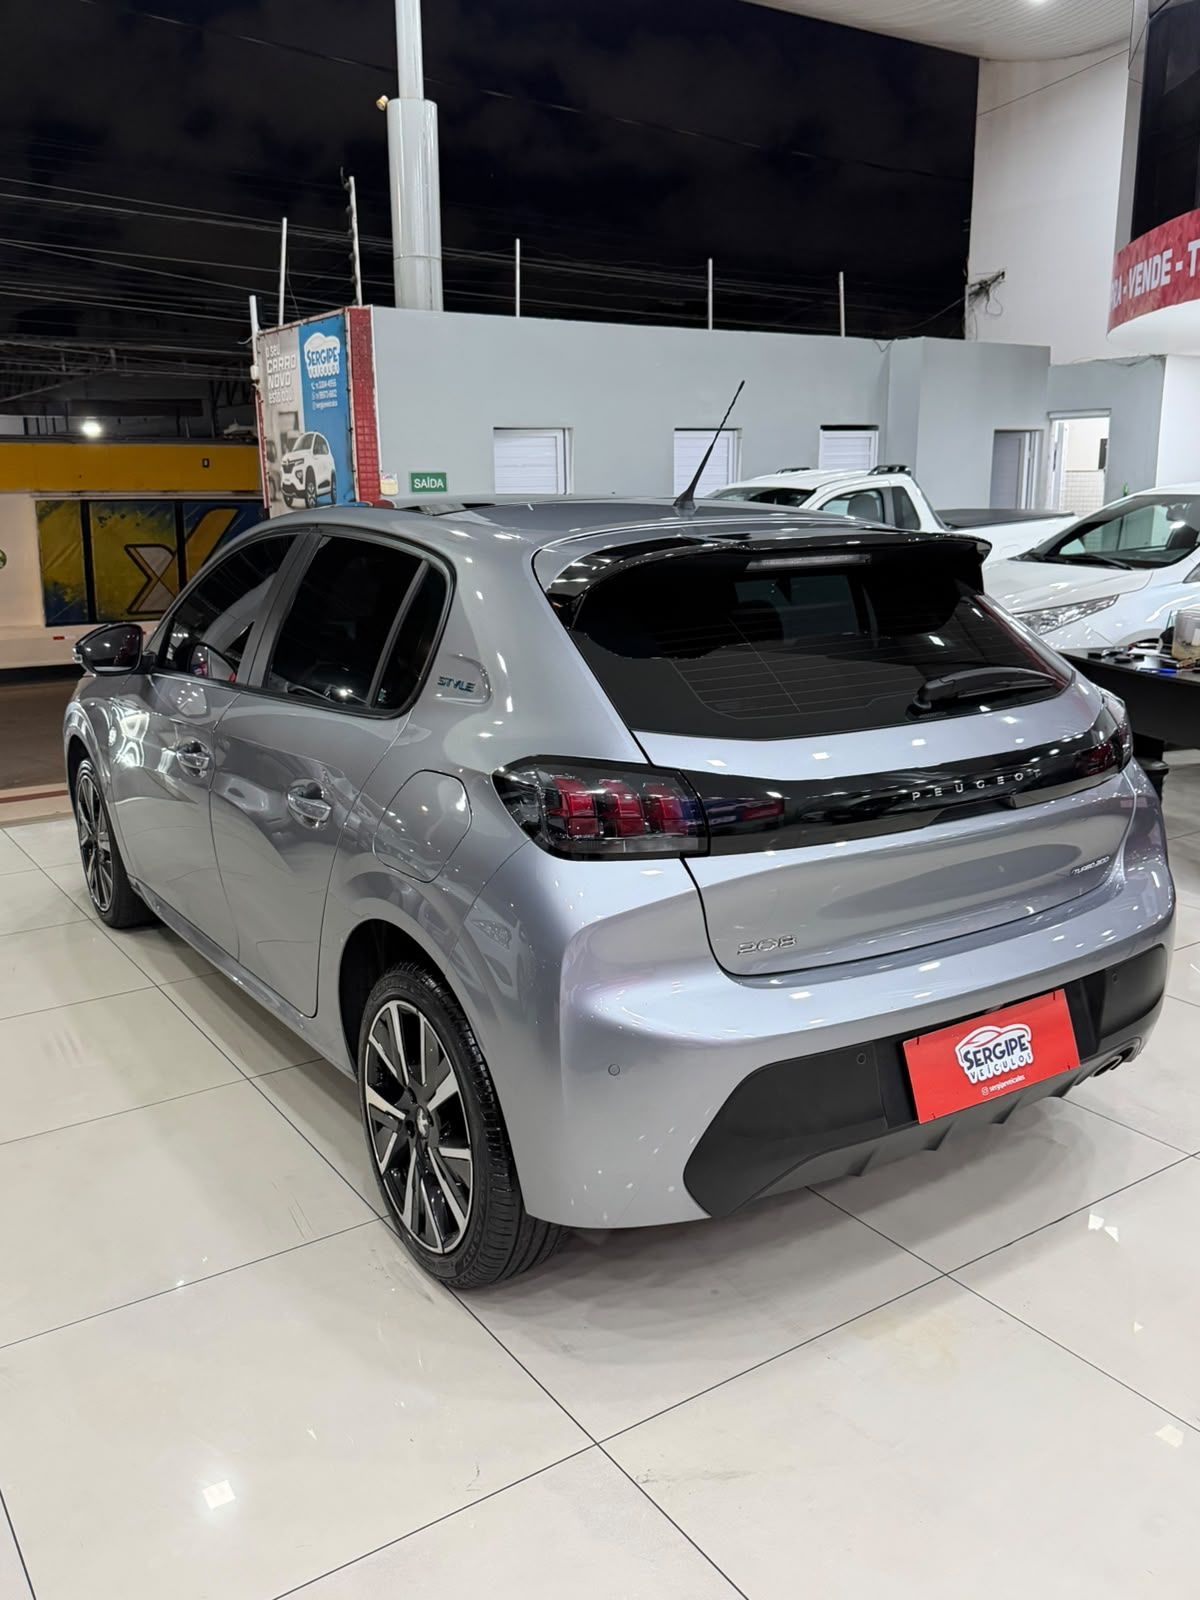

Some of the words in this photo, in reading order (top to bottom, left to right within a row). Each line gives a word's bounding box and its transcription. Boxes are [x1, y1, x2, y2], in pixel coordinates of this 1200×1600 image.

[1128, 248, 1173, 300] VENDE
[267, 354, 296, 374] CARRO
[307, 347, 338, 366] SERGIPE
[268, 373, 292, 390] NOVO
[414, 476, 445, 489] SAÍDA
[437, 676, 476, 693] STYLE
[912, 768, 1041, 801] PEUGEOT
[737, 934, 797, 955] 208
[963, 1034, 1029, 1071] SERGIPE
[970, 1052, 1031, 1080] VEÍCULOS
